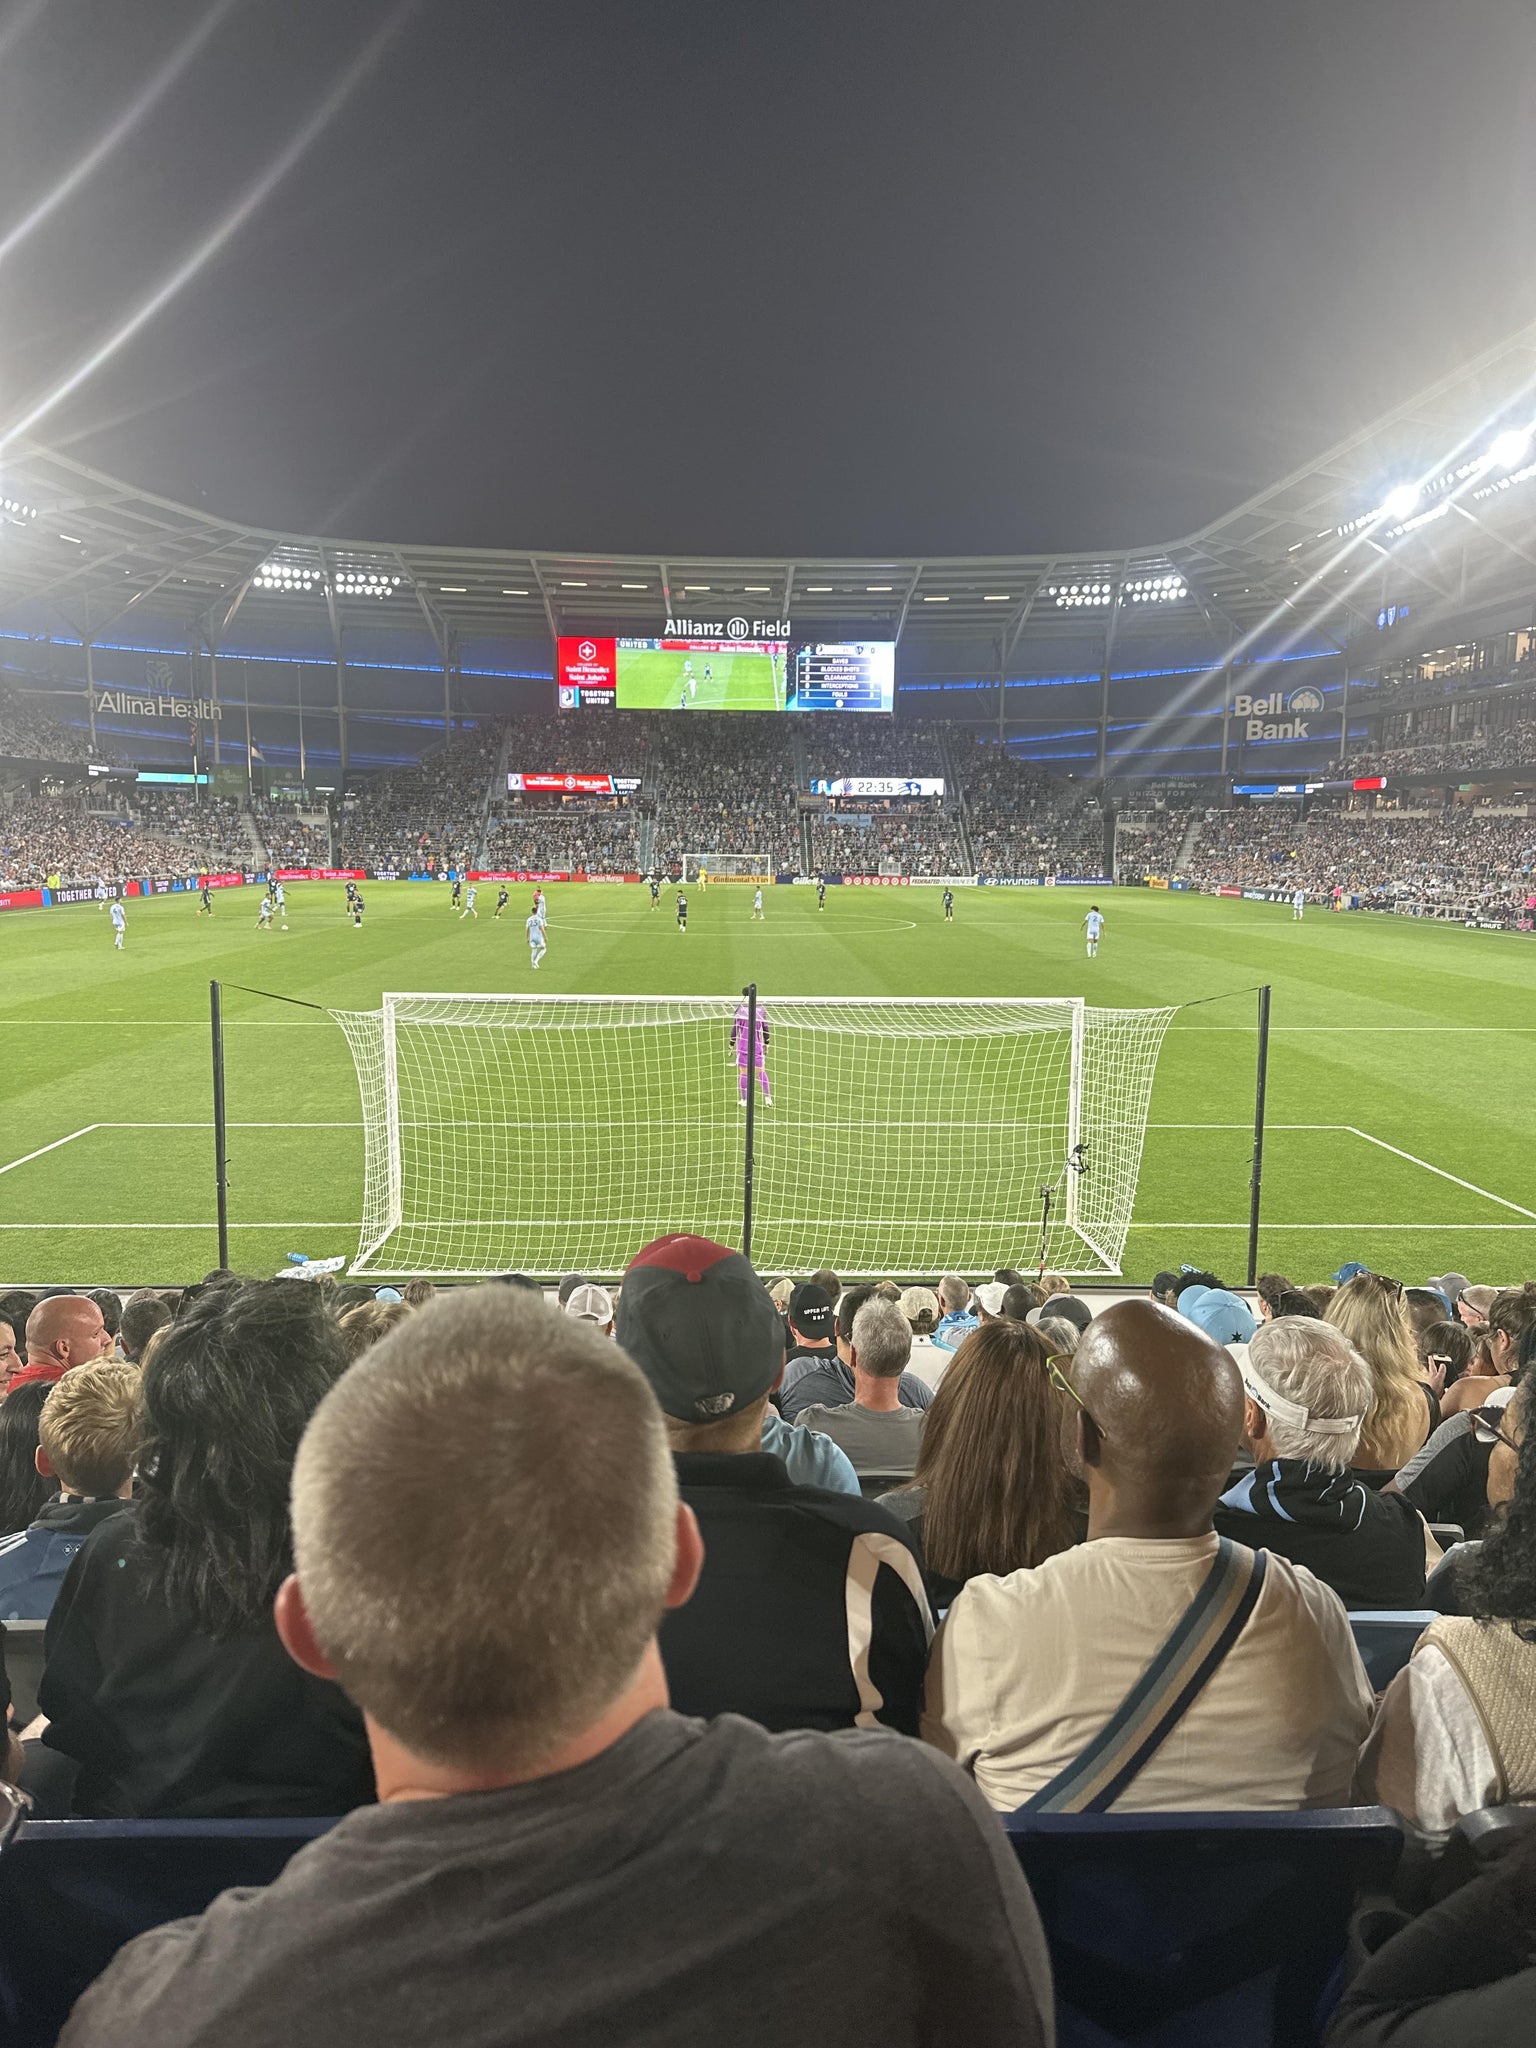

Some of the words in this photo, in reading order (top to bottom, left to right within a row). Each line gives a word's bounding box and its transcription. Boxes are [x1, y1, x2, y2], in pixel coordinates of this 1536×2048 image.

[664, 619, 723, 635] Allianz
[753, 620, 791, 637] Field
[620, 640, 648, 649] UNITED
[97, 691, 156, 717] Allina
[160, 696, 222, 720] Health
[1235, 693, 1283, 717] Bell
[1246, 718, 1309, 740] Bank
[858, 782, 893, 793] 22:35
[587, 874, 603, 883] Captain
[604, 874, 625, 883] Morgan
[713, 875, 750, 883] Continental
[1000, 878, 1039, 886] HYUNDAI
[56, 889, 92, 903] TOGETHER
[94, 886, 117, 899] UTED
[1257, 1394, 1271, 1410] Bank
